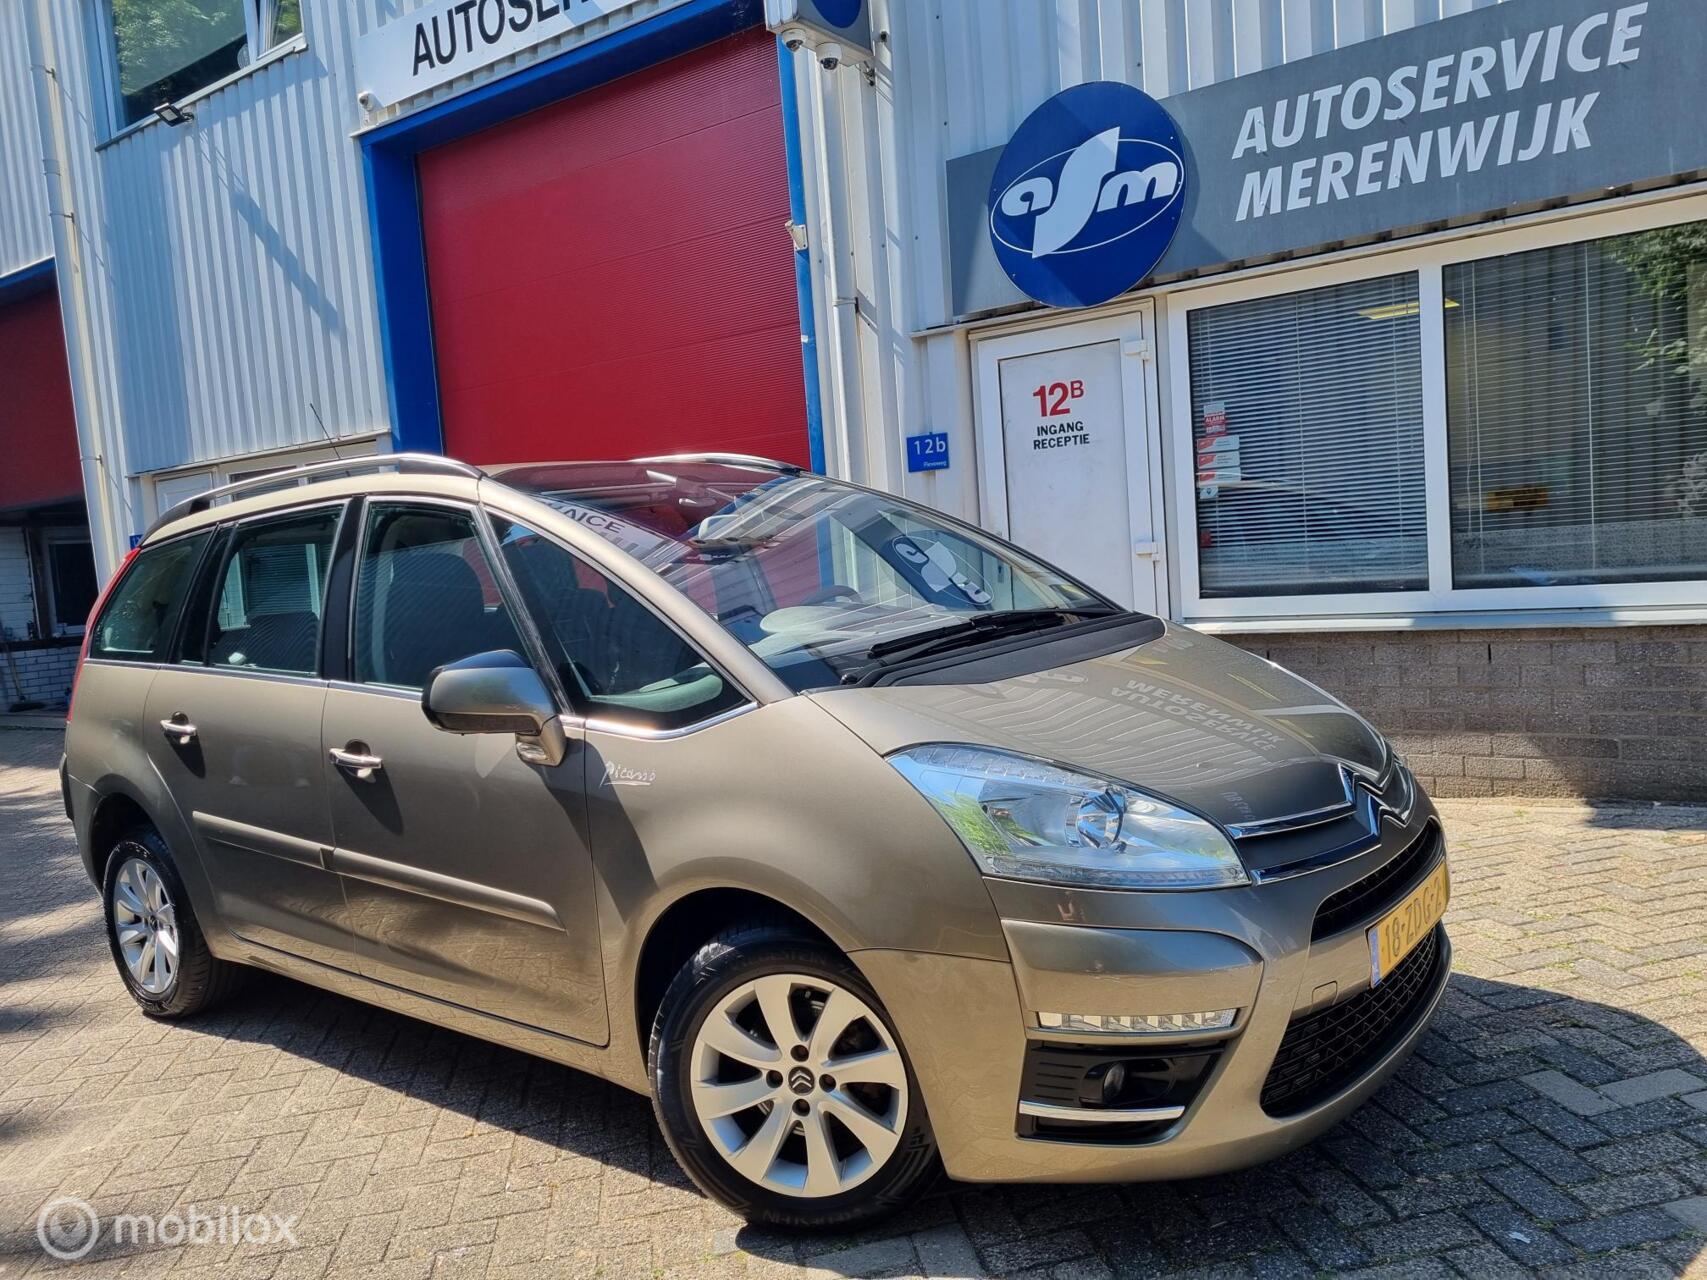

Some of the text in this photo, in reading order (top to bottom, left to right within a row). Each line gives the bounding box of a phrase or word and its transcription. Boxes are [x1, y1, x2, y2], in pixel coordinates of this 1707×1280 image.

[1231, 2, 1649, 159] AUTOSERVICE
[1235, 91, 1600, 222] MERENWIJK
[1033, 380, 1084, 417] 12B
[1033, 433, 1090, 450] RECEPTIE
[1037, 421, 1083, 436] INGANG
[914, 436, 946, 455] 12b
